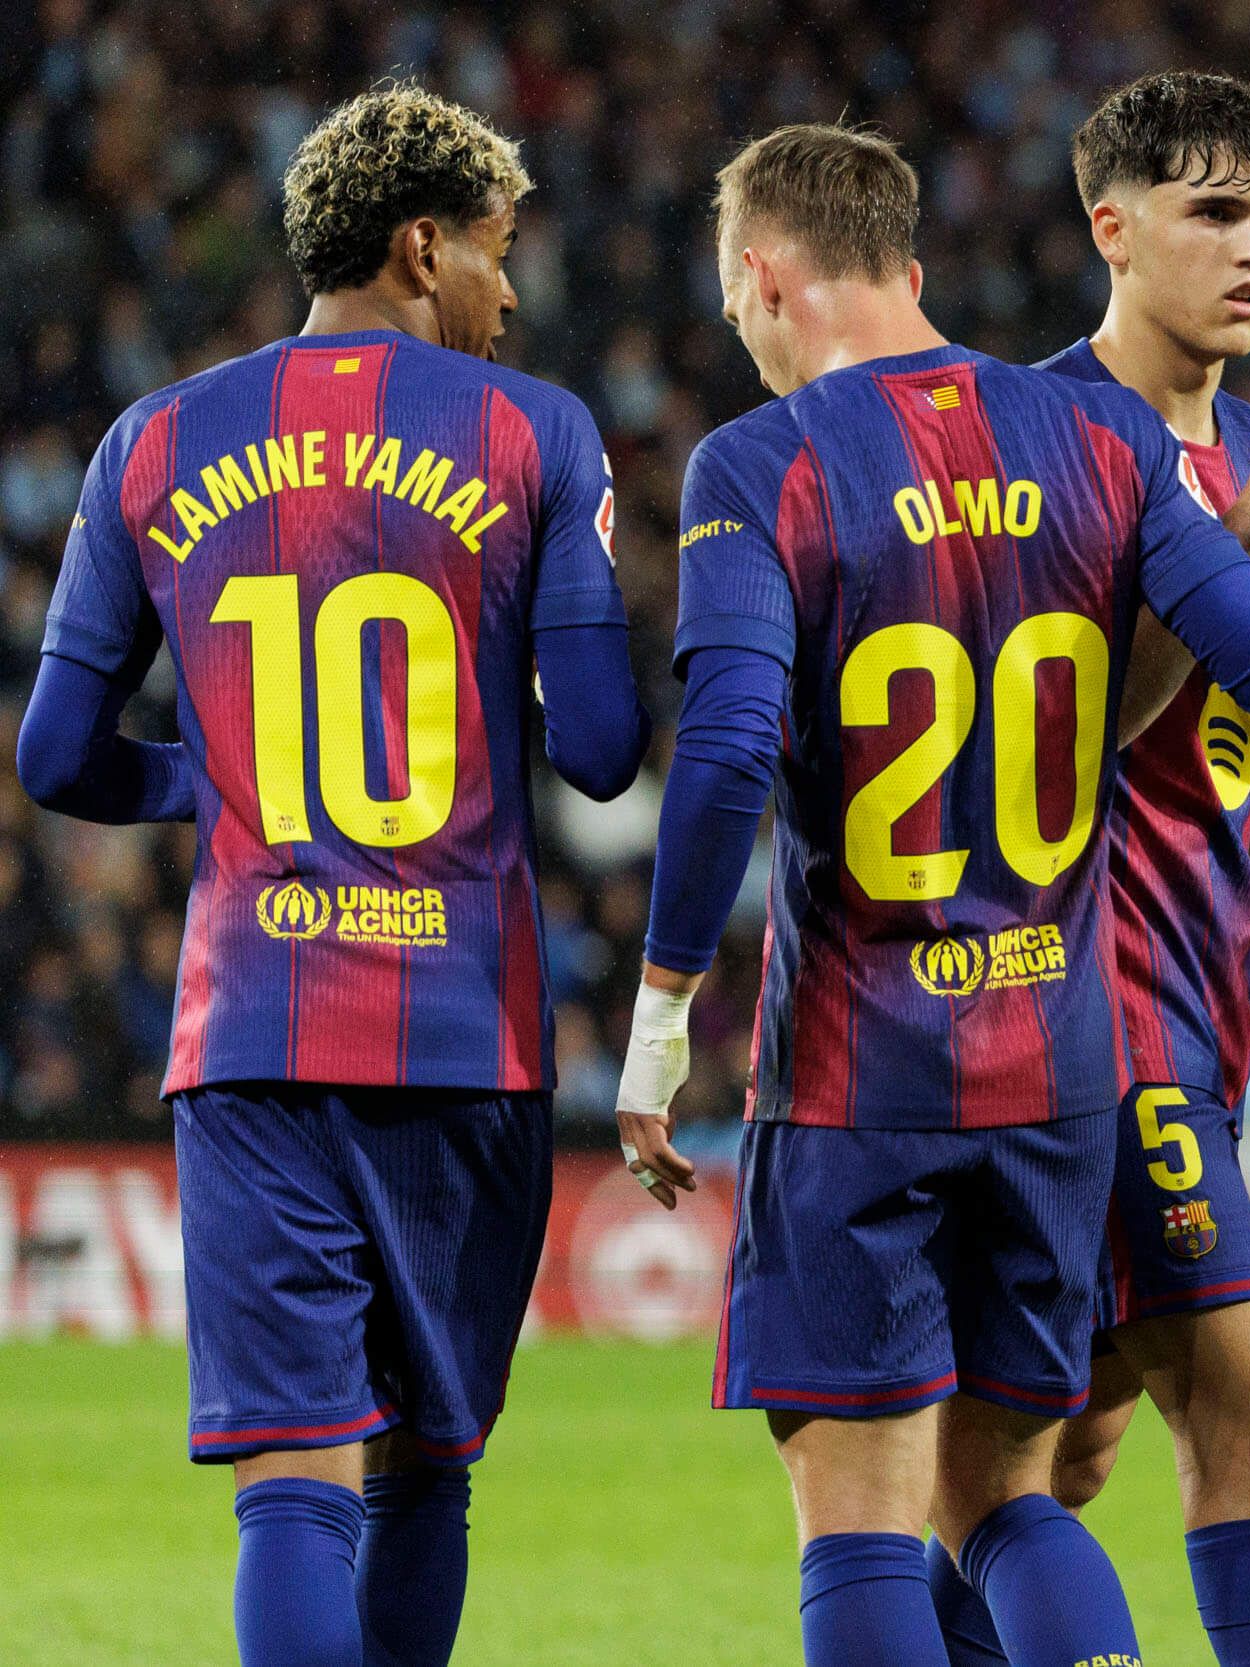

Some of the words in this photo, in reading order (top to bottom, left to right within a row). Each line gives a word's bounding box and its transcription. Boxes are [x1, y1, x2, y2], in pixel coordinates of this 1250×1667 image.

[146, 429, 327, 564] LAMINE
[343, 431, 509, 555] YAMAL
[893, 477, 1043, 545] OLMO
[679, 519, 721, 549] LIGHT
[724, 519, 744, 533] tv
[208, 570, 458, 849] 10
[839, 610, 1110, 902] 20
[335, 910, 447, 936] ACNUR
[336, 885, 445, 913] UNHCR
[338, 933, 355, 942] The
[356, 933, 372, 943] UN
[373, 934, 411, 946] Refugee
[412, 936, 447, 947] Agency
[1135, 1087, 1204, 1192] 5
